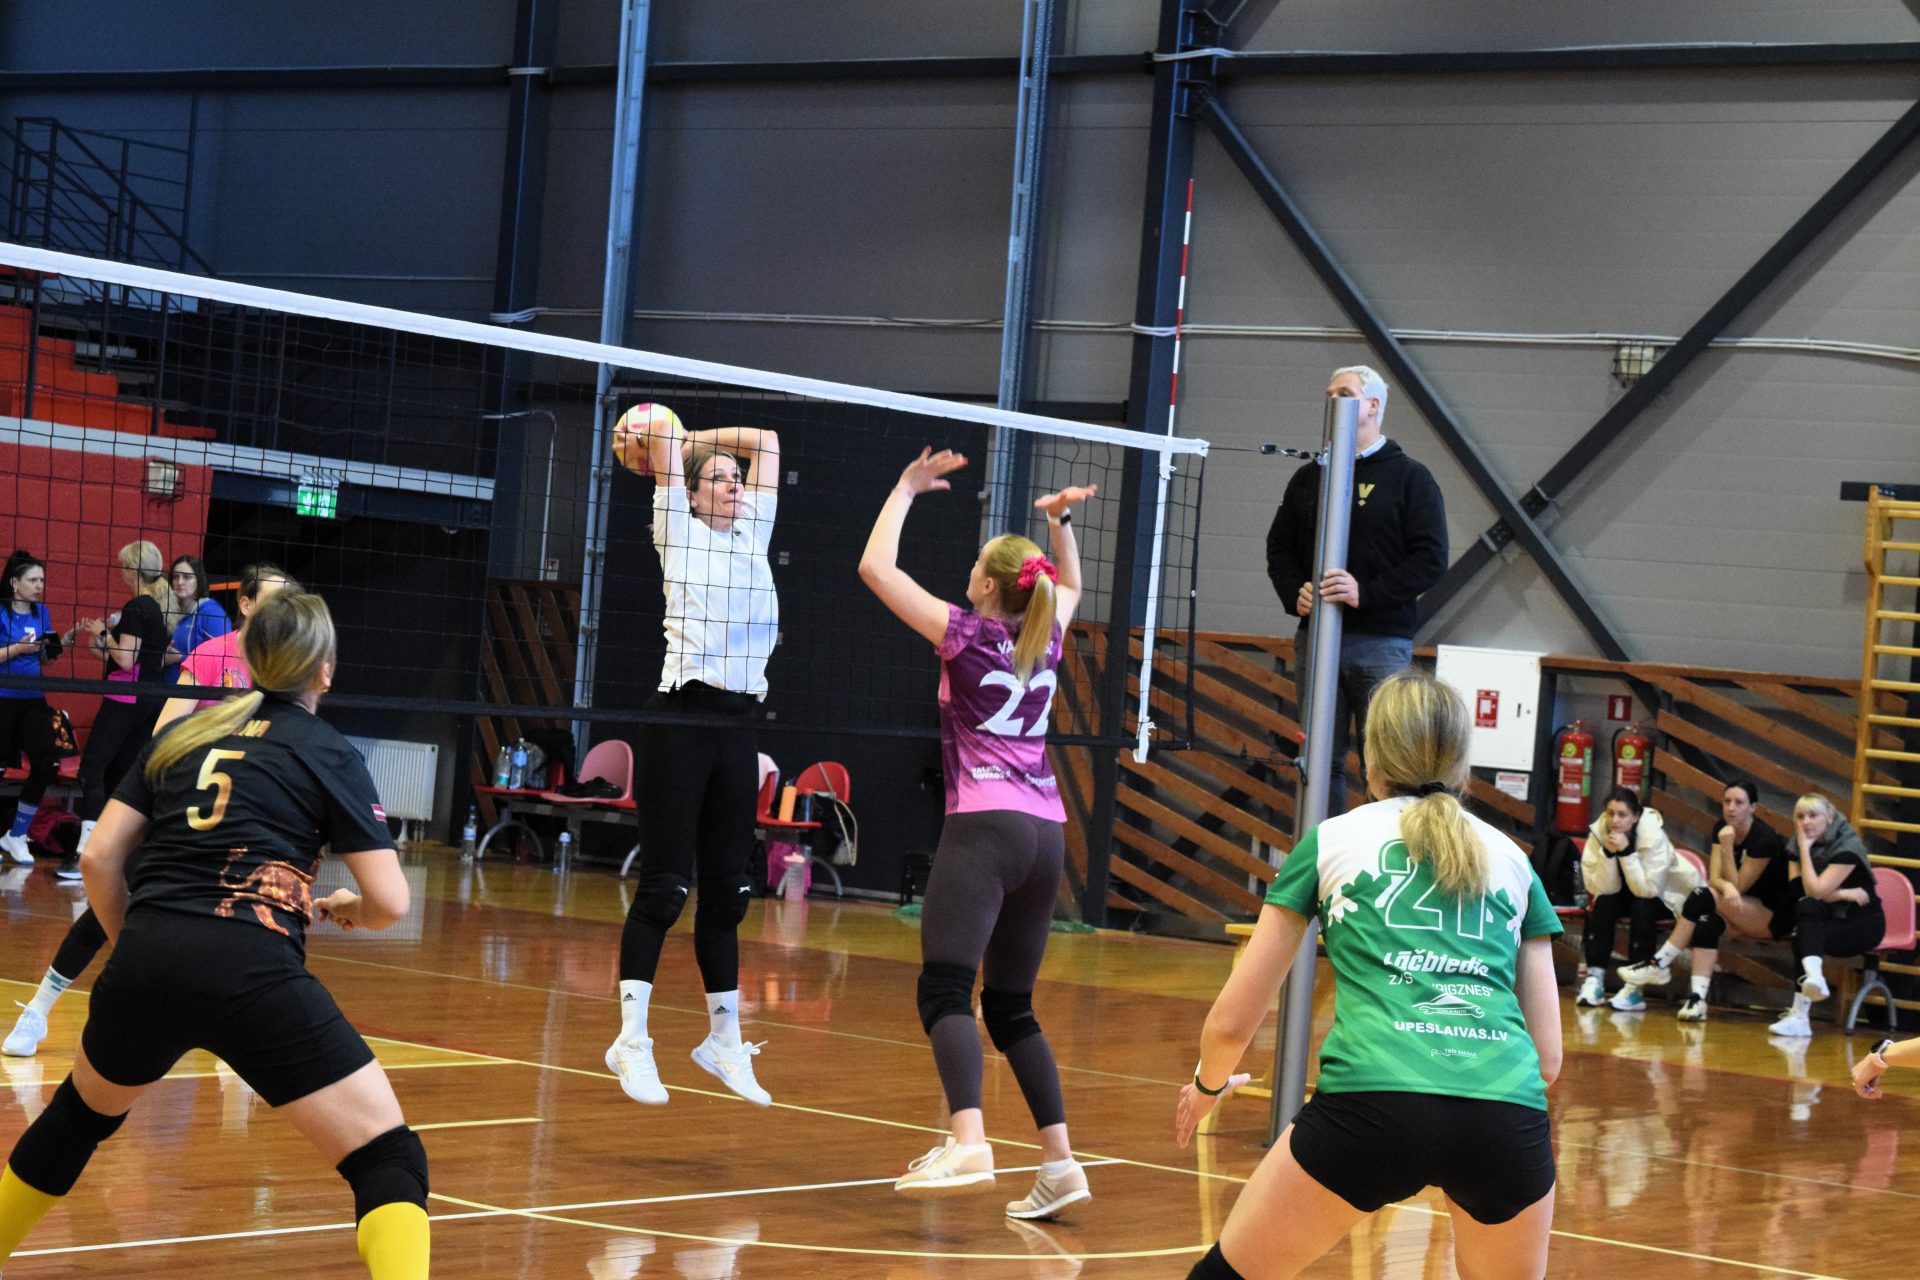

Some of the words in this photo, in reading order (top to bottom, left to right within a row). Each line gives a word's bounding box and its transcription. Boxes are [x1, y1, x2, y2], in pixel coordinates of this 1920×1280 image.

[976, 669, 1057, 737] 22
[186, 748, 246, 831] 5
[1394, 1020, 1508, 1041] UPESLAIVAS.LV
